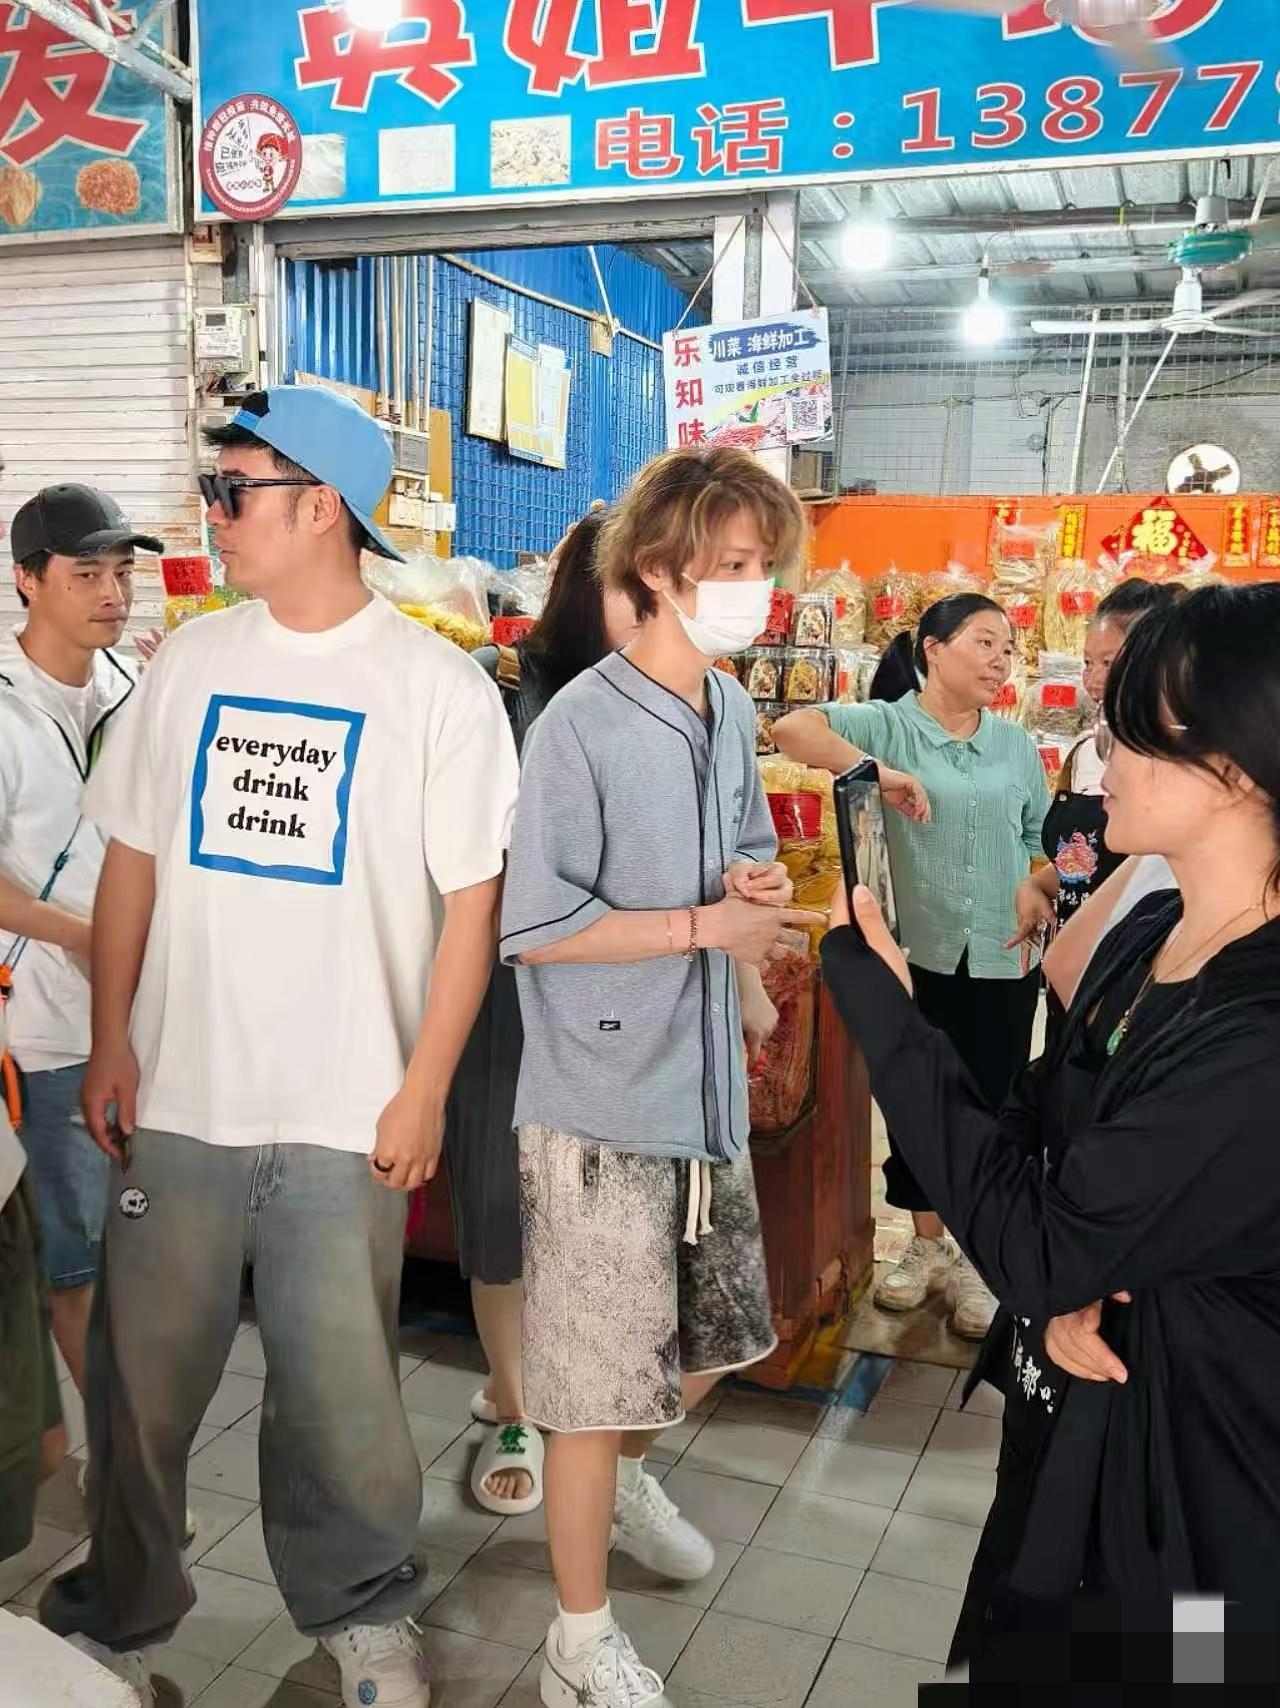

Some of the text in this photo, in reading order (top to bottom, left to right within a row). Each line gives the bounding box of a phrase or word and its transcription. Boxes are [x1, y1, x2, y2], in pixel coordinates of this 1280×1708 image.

[713, 329, 810, 359] 川菜 海鲜加工
[736, 355, 799, 376] 诚信经营
[674, 336, 706, 447] 乐知味
[1132, 509, 1178, 556] 福
[215, 735, 337, 773] everyday
[232, 768, 310, 802] drink
[227, 805, 307, 839] drink
